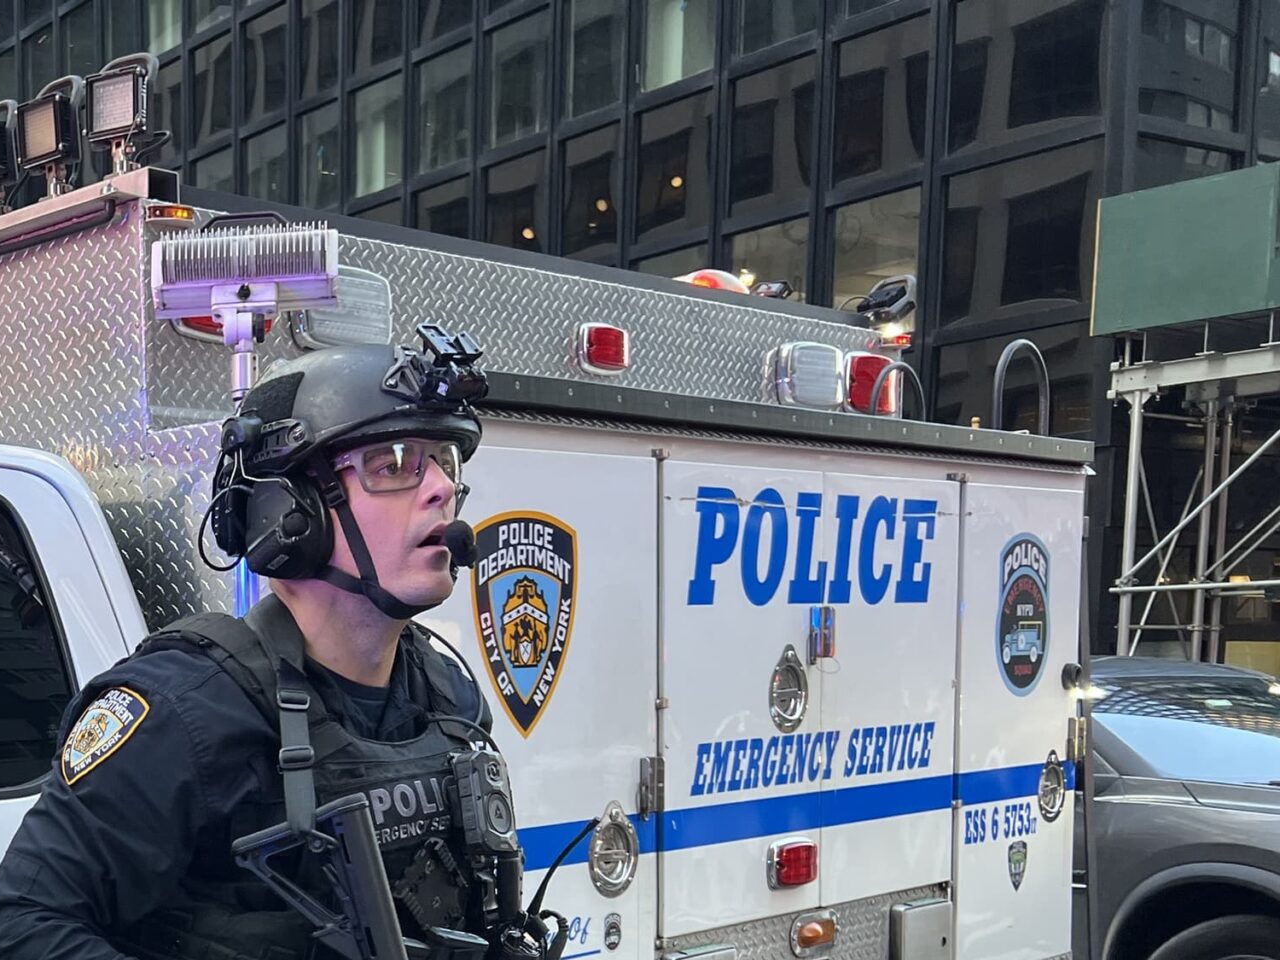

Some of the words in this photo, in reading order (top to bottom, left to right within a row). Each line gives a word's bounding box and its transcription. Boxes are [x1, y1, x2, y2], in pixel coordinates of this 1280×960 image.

[498, 522, 554, 550] POLICE
[688, 486, 938, 606] POLICE
[478, 545, 572, 586] DEPARTMENT
[1004, 543, 1047, 585] POLICE
[479, 611, 502, 663] CITY
[497, 671, 516, 697] OF
[532, 661, 556, 707] NEW
[552, 598, 572, 653] YORK
[74, 756, 92, 774] NEW
[95, 732, 122, 756] YORK
[690, 731, 840, 796] EMERGENCY
[844, 722, 935, 777] SERVICE
[964, 809, 986, 845] ESS
[991, 806, 999, 841] 6
[569, 917, 591, 944] Of
